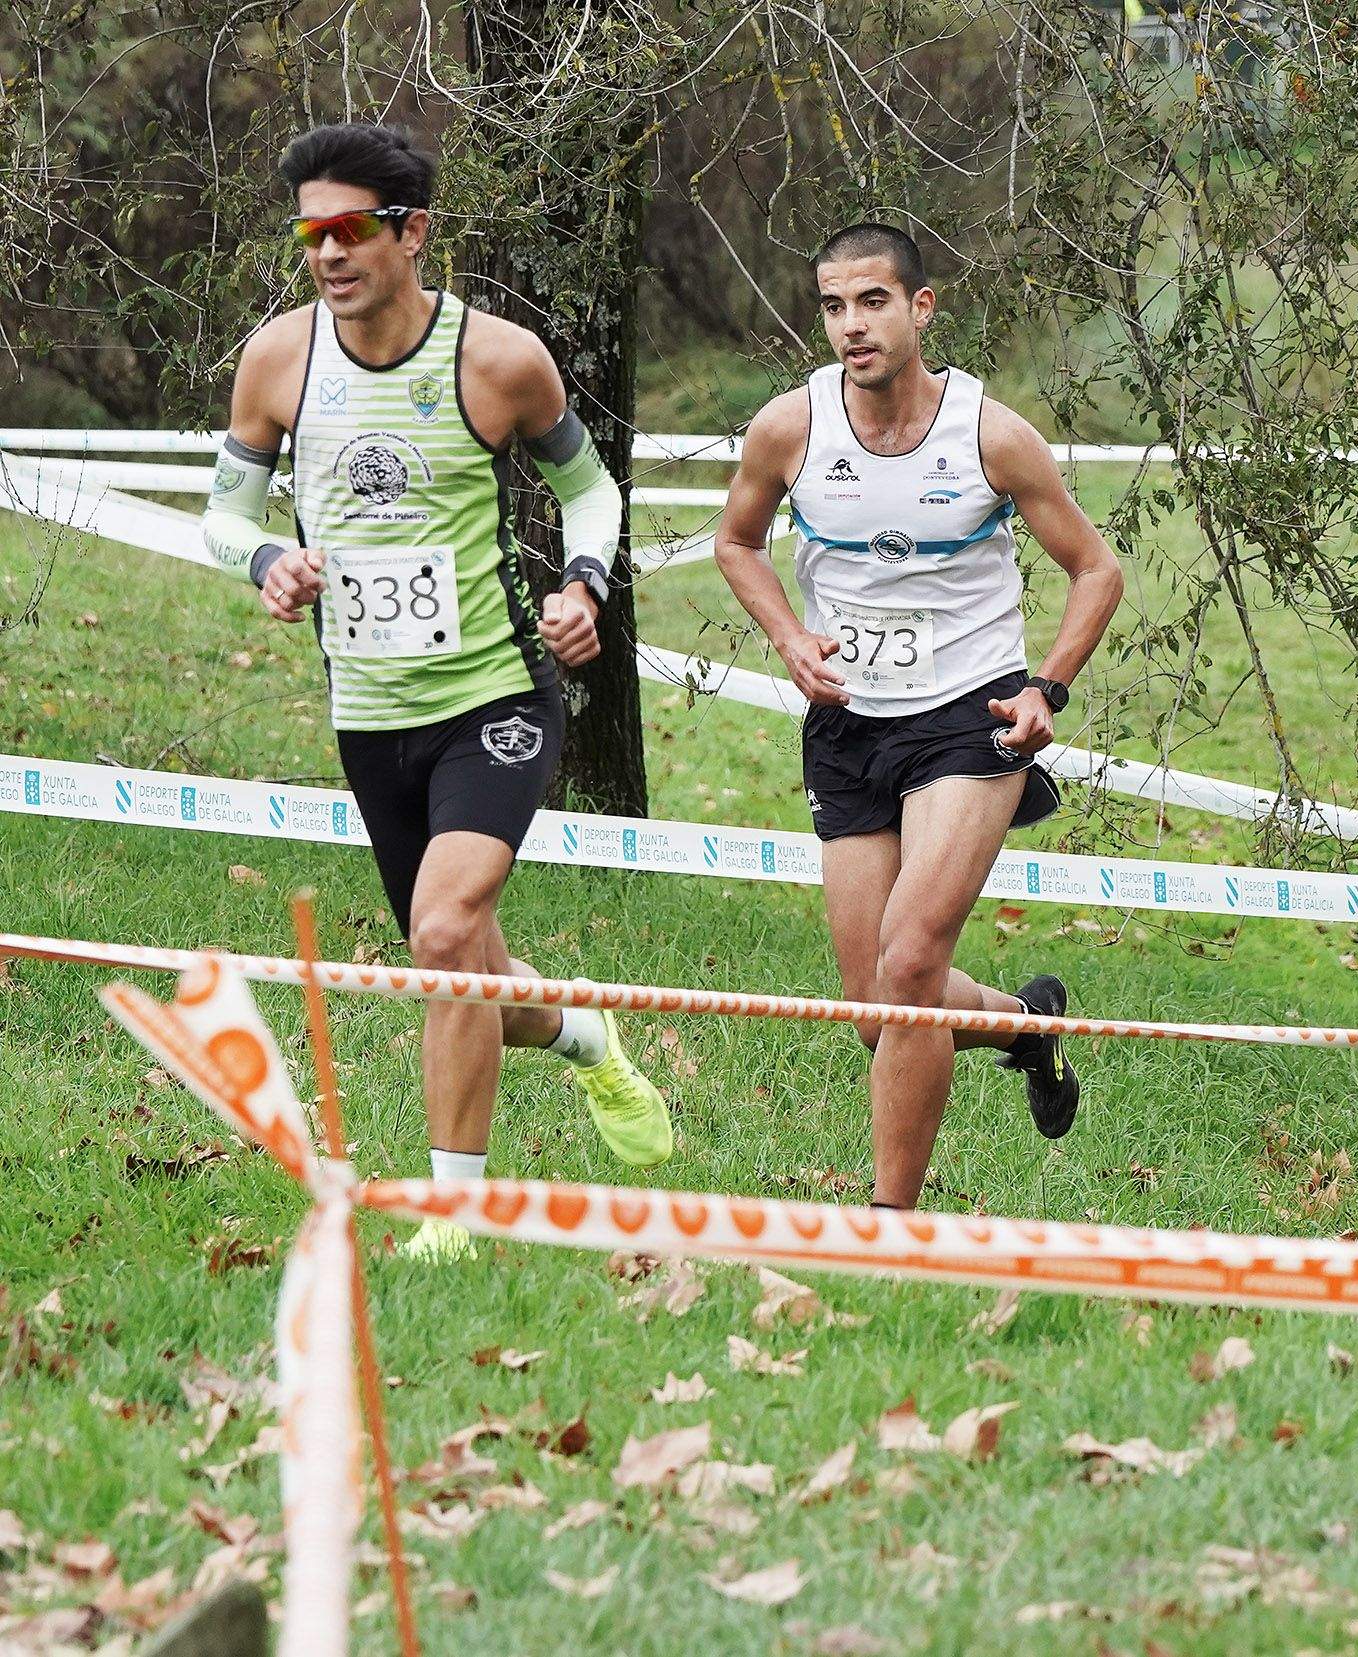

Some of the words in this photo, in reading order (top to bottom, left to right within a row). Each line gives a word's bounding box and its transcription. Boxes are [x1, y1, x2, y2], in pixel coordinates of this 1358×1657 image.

[382, 512, 392, 520] de
[342, 575, 440, 622] 338
[840, 625, 918, 668] 373
[0, 770, 22, 784] ORTE
[43, 775, 77, 790] XUNTA
[43, 791, 56, 804] DE
[58, 793, 99, 808] GALICIA
[140, 785, 178, 800] DEPORTE
[199, 791, 232, 807] XUNTA
[140, 802, 176, 817] GALEGO
[199, 807, 213, 820] DE
[214, 808, 253, 824] GALICIA
[292, 801, 330, 816] DEPORTE
[293, 818, 328, 832] GALEGO
[350, 822, 362, 835] DE
[584, 828, 621, 842] DEPORTE
[639, 833, 670, 847] XUNTA
[521, 839, 548, 852] LICIA
[585, 844, 618, 858] GALEGO
[724, 841, 759, 854] DEPORTE
[777, 846, 807, 859] XUNTA
[639, 848, 651, 861] DE
[653, 849, 689, 864] GALICIA
[725, 856, 757, 870] GALEGO
[777, 860, 790, 872] DE
[992, 863, 1024, 876] DEPORTE
[1041, 866, 1070, 879] XUNTA
[992, 878, 1023, 891] GALEGO
[1120, 872, 1152, 885] DEPORTE
[1168, 876, 1196, 888] XUNTA
[1041, 881, 1053, 893] DE
[1055, 881, 1088, 895] GALICIA
[1120, 887, 1150, 899] GALEGO
[1244, 881, 1275, 893] DEPORTE
[1292, 884, 1318, 896] XUNTA
[1168, 890, 1179, 901] DE
[1181, 890, 1213, 904] GALICIA
[1245, 896, 1273, 908] GALEGO
[1292, 898, 1301, 910] DE
[1303, 898, 1334, 911] GALICIA
